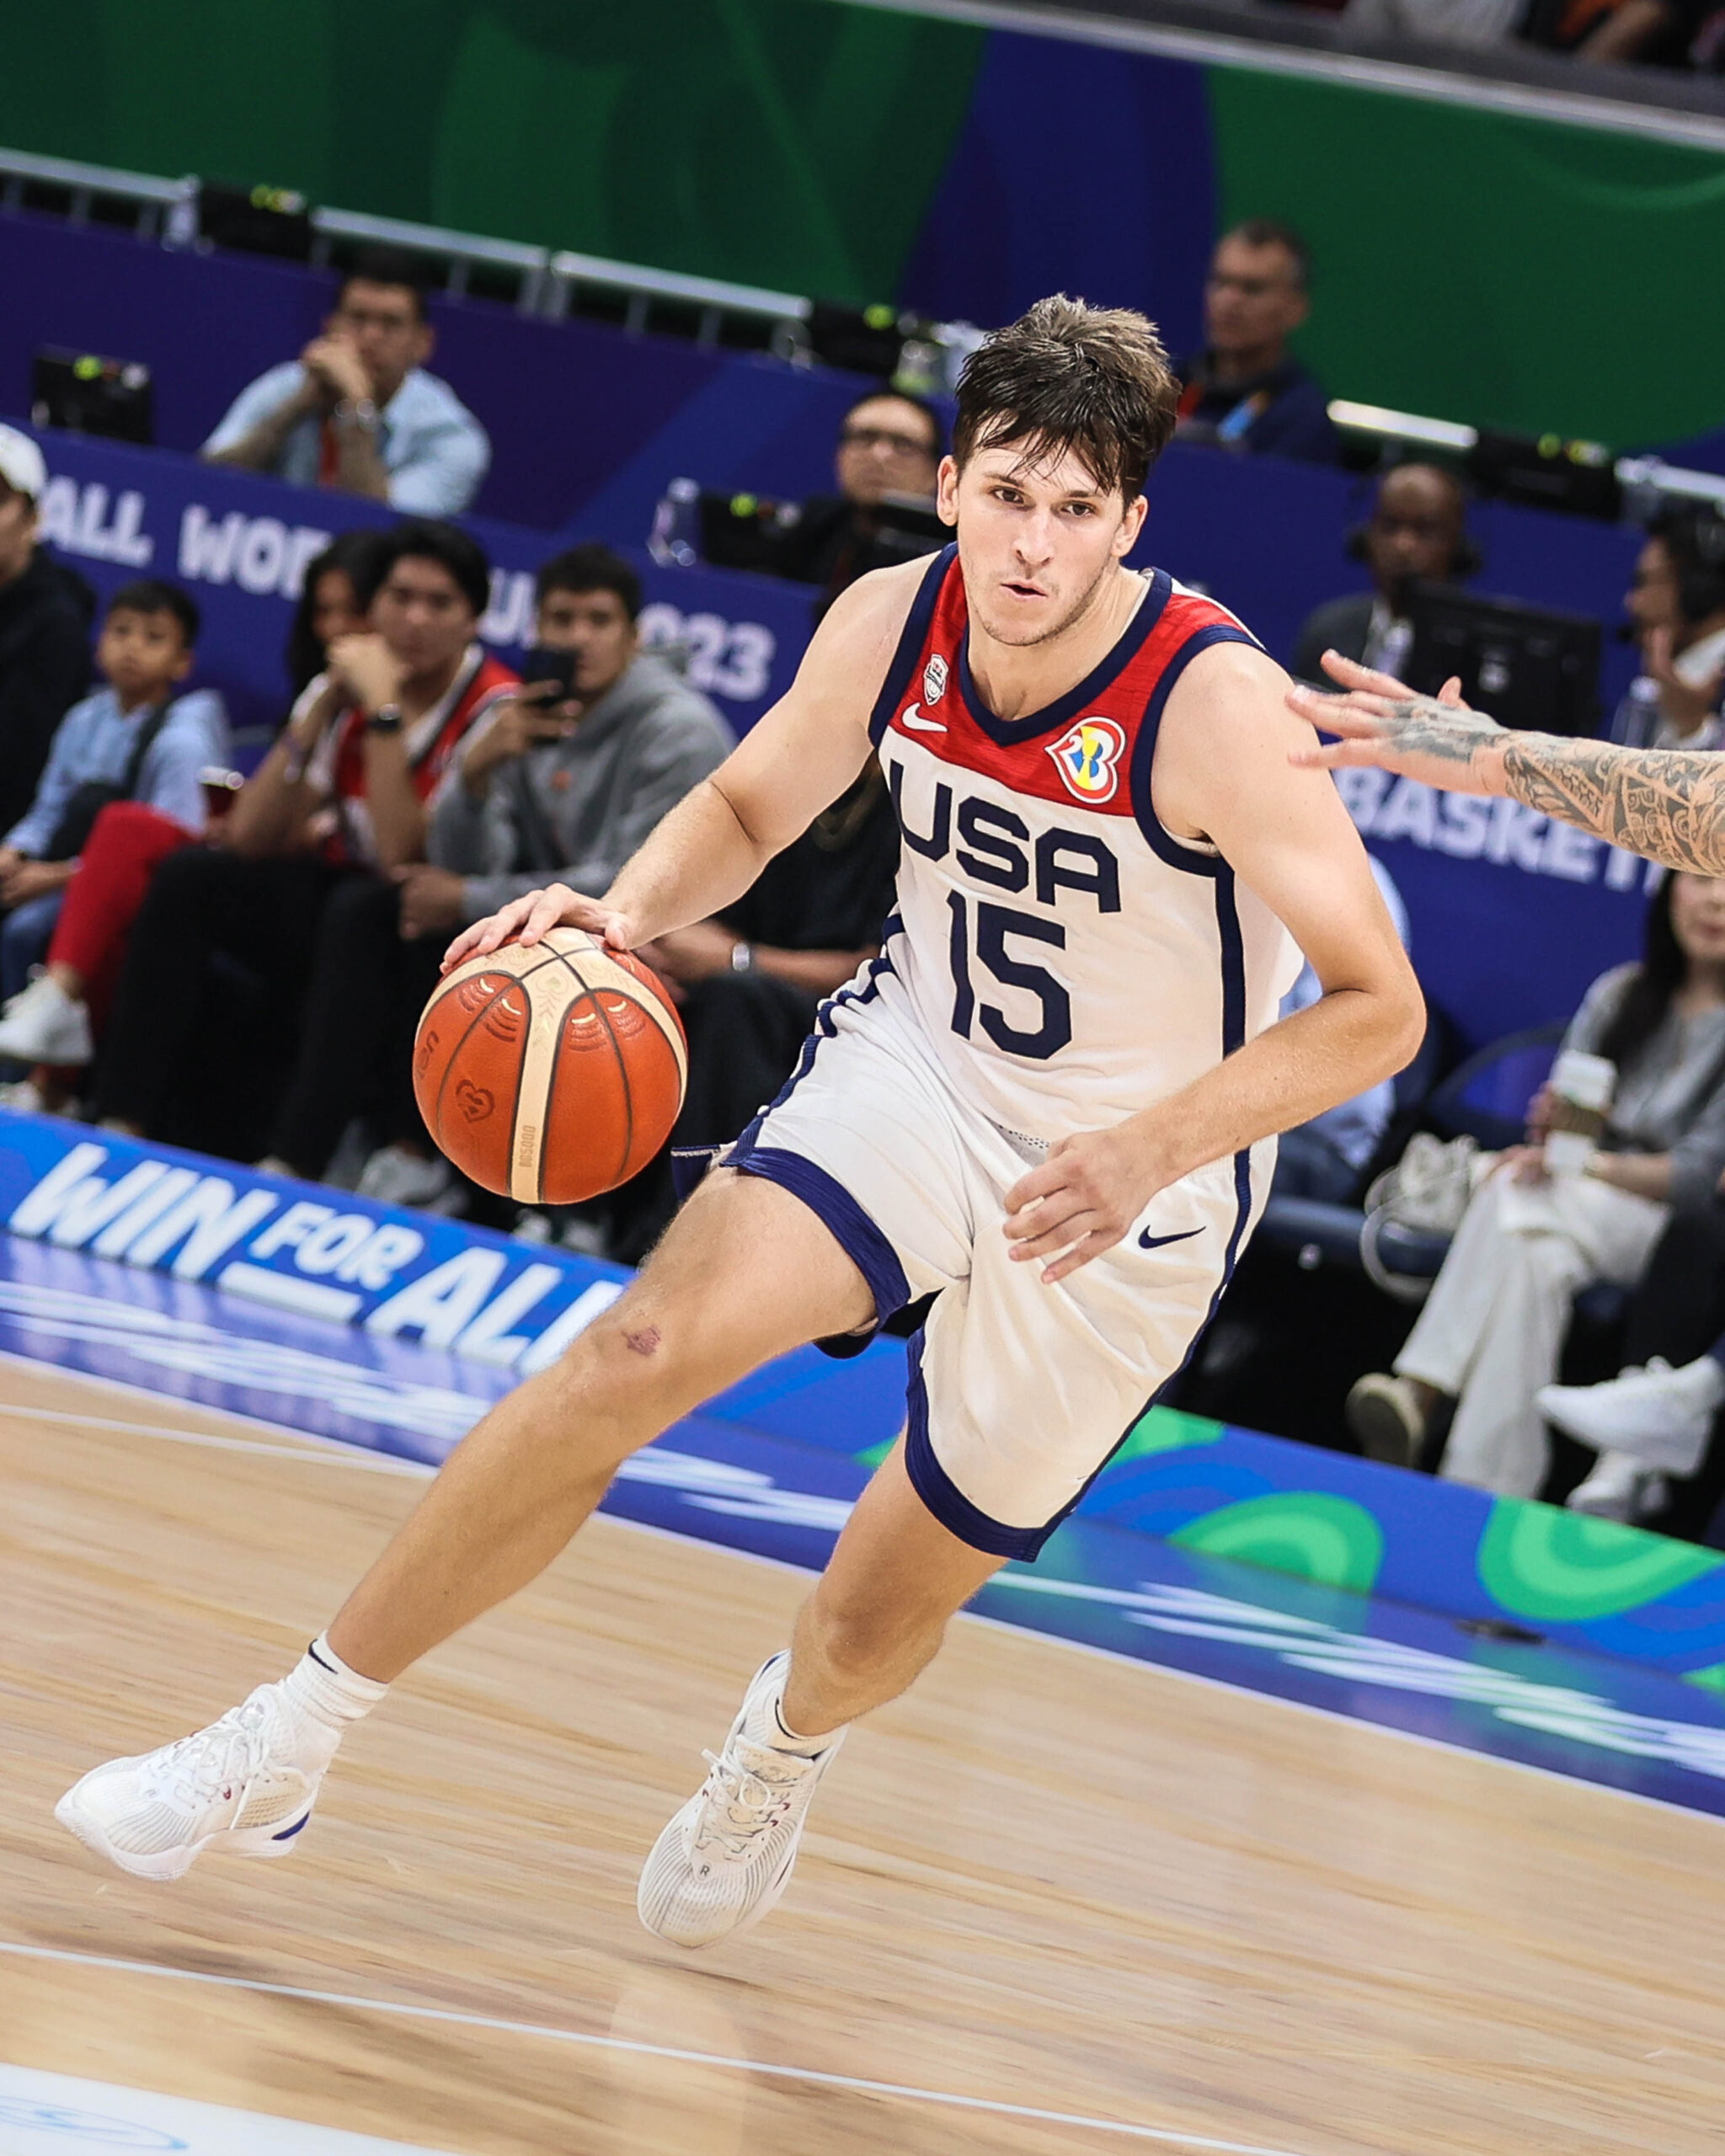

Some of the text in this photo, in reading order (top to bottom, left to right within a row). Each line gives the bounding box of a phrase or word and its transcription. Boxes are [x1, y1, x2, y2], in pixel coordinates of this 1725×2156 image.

[636, 601, 777, 702] 023
[889, 757, 1122, 914] USA
[1332, 765, 1664, 894] BASKE
[946, 889, 1072, 1061] 15
[8, 1142, 280, 1283] WIN
[248, 1200, 424, 1291] FOR
